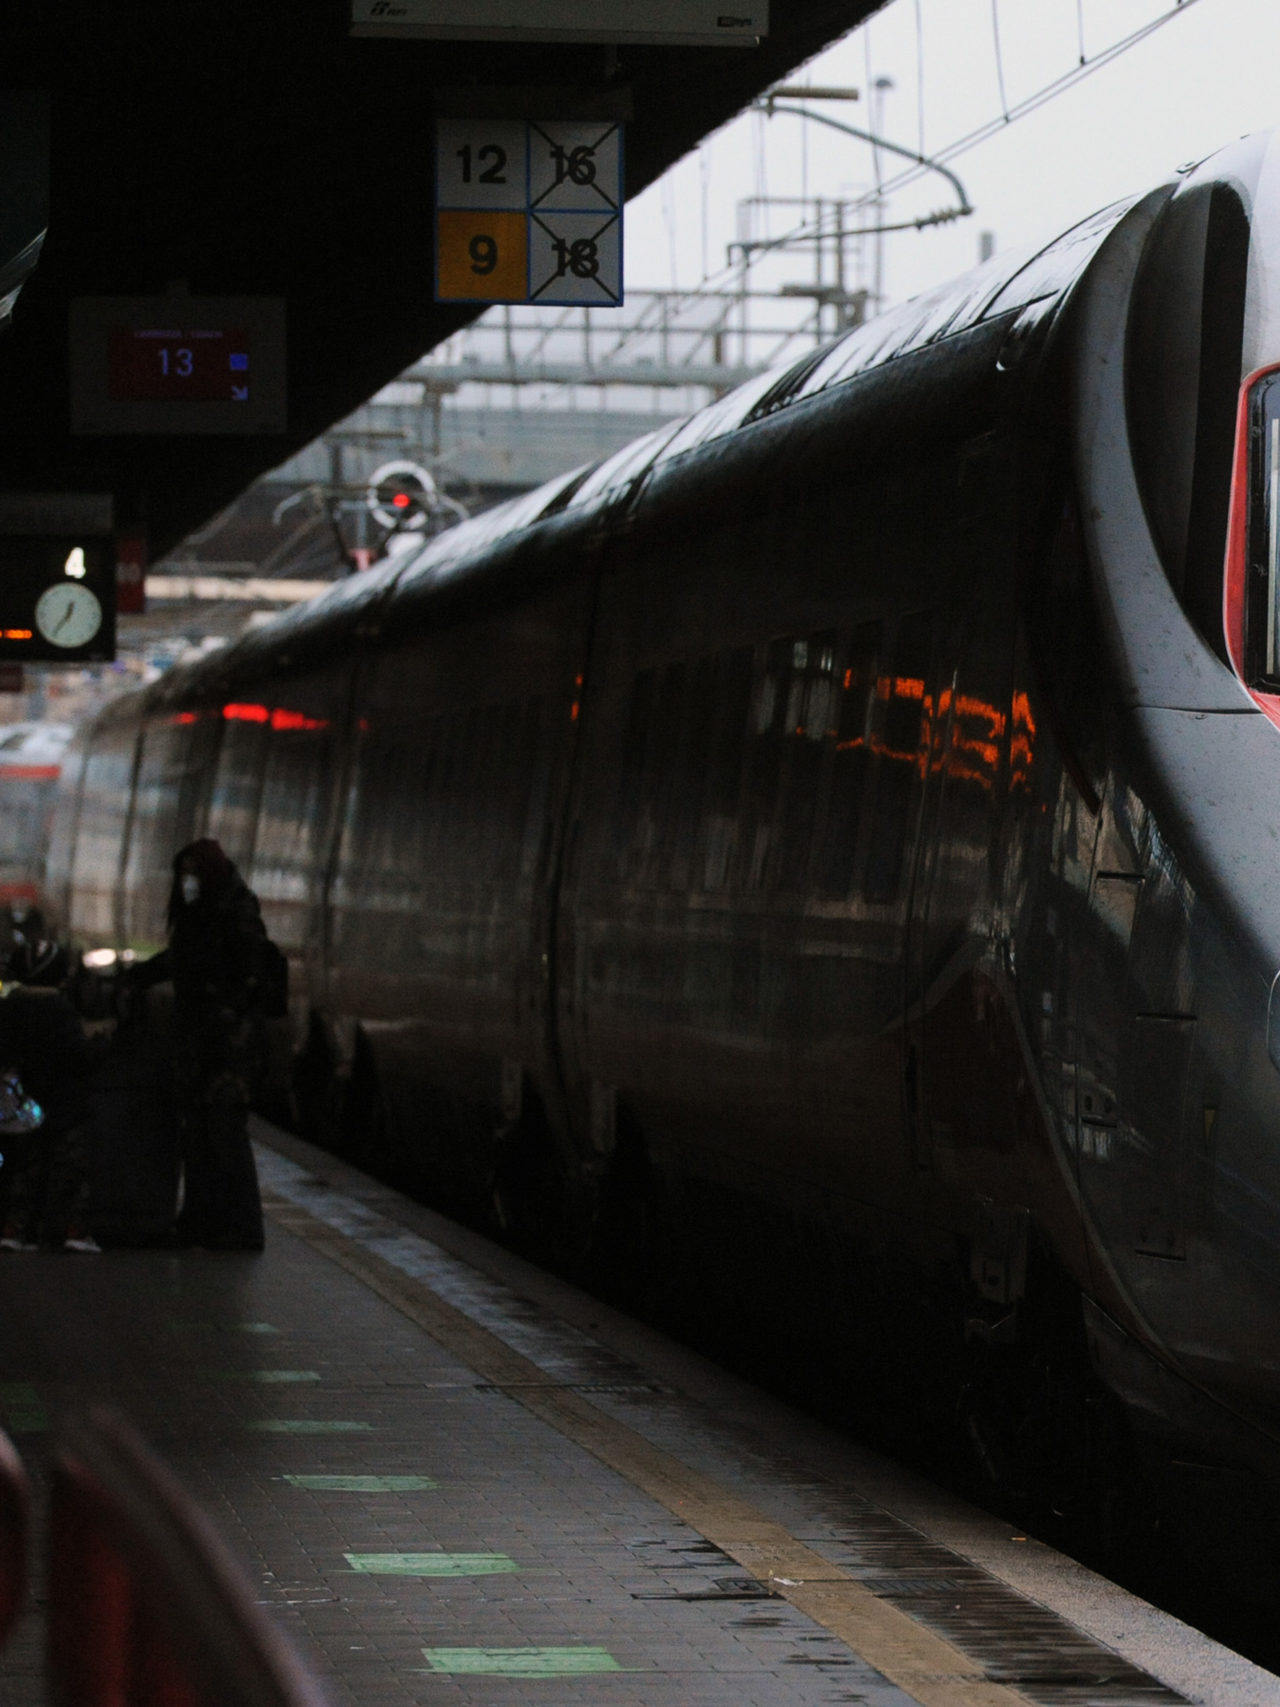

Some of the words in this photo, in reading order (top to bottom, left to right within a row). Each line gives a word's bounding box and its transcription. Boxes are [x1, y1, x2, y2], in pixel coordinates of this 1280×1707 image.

[457, 145, 507, 184] 12
[551, 145, 596, 185] 16
[468, 234, 498, 276] 9
[551, 239, 599, 278] 18
[158, 347, 194, 377] 13
[64, 546, 87, 579] 4
